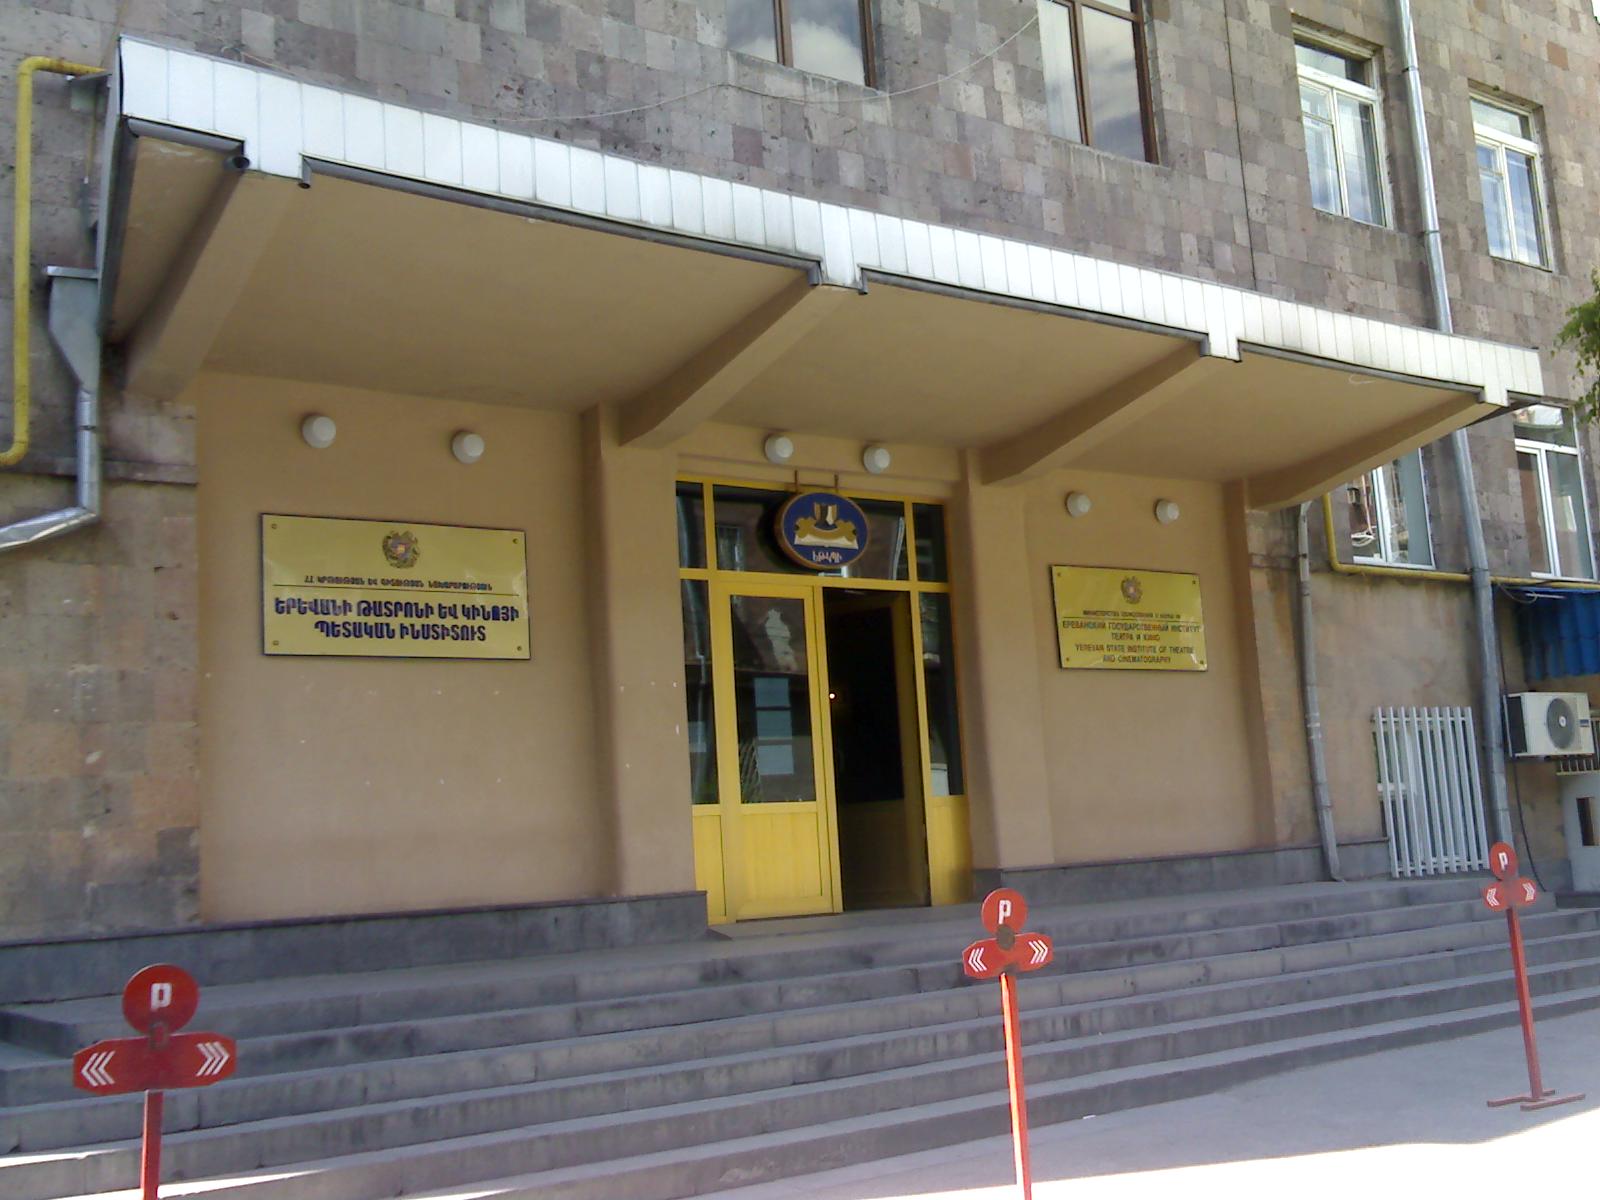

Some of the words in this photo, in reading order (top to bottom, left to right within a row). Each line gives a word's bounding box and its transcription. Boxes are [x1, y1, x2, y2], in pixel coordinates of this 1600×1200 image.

[274, 597, 353, 617] ԵՐԵՎԱՆԻ
[357, 600, 434, 619] ԹԱՏՐՈՆԻ
[438, 603, 459, 620] ԵՎ
[461, 604, 520, 622] ԿԻՆՈՅԻ
[314, 620, 396, 639] ՊԵՏԱԿԱՆ
[399, 622, 487, 641] ԻՆՍՏԻՏՈՒՏ
[998, 899, 1011, 925] P
[150, 982, 172, 1011] P
